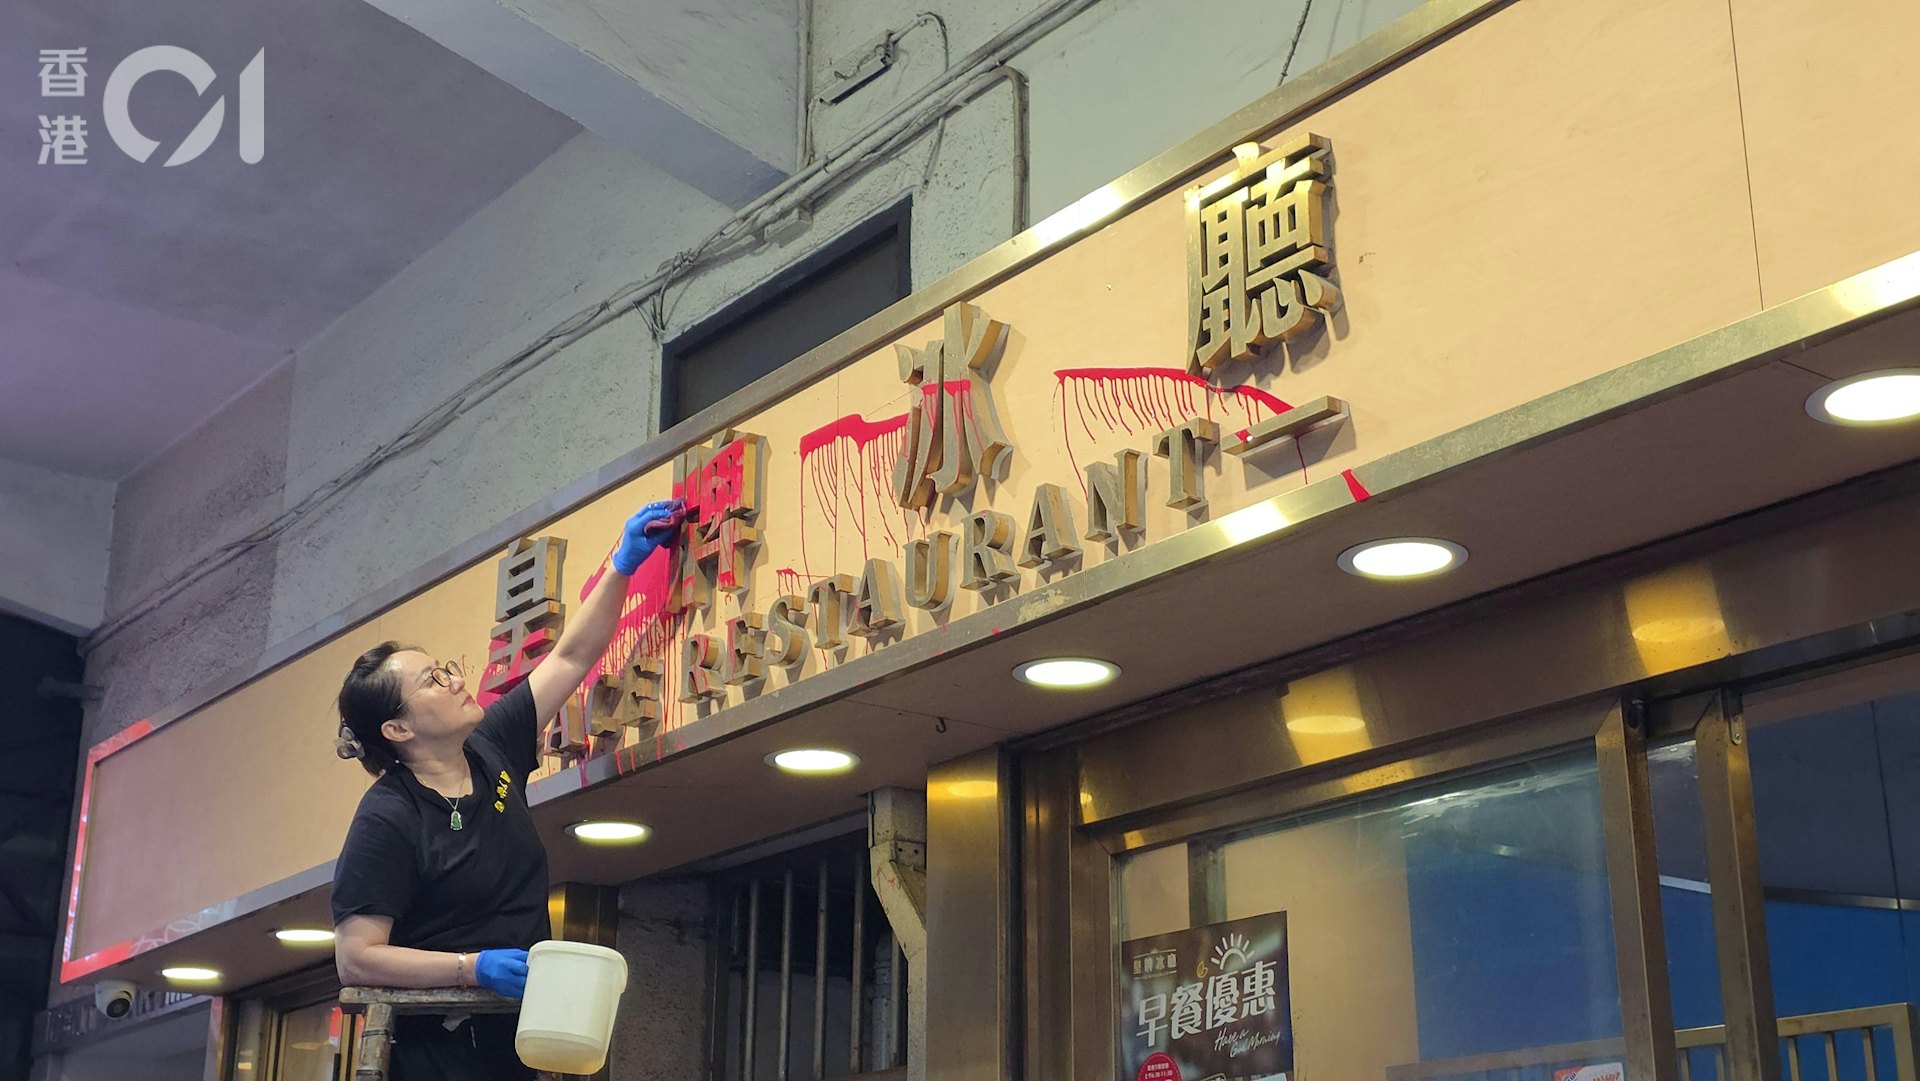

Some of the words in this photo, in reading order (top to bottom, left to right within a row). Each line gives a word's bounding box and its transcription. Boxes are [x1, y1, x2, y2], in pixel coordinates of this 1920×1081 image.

[678, 418, 1219, 704] RESTAURANT
[1136, 960, 1277, 1047] 早餐優惠
[1214, 1027, 1239, 1051] Have
[1248, 1031, 1281, 1051] Morning
